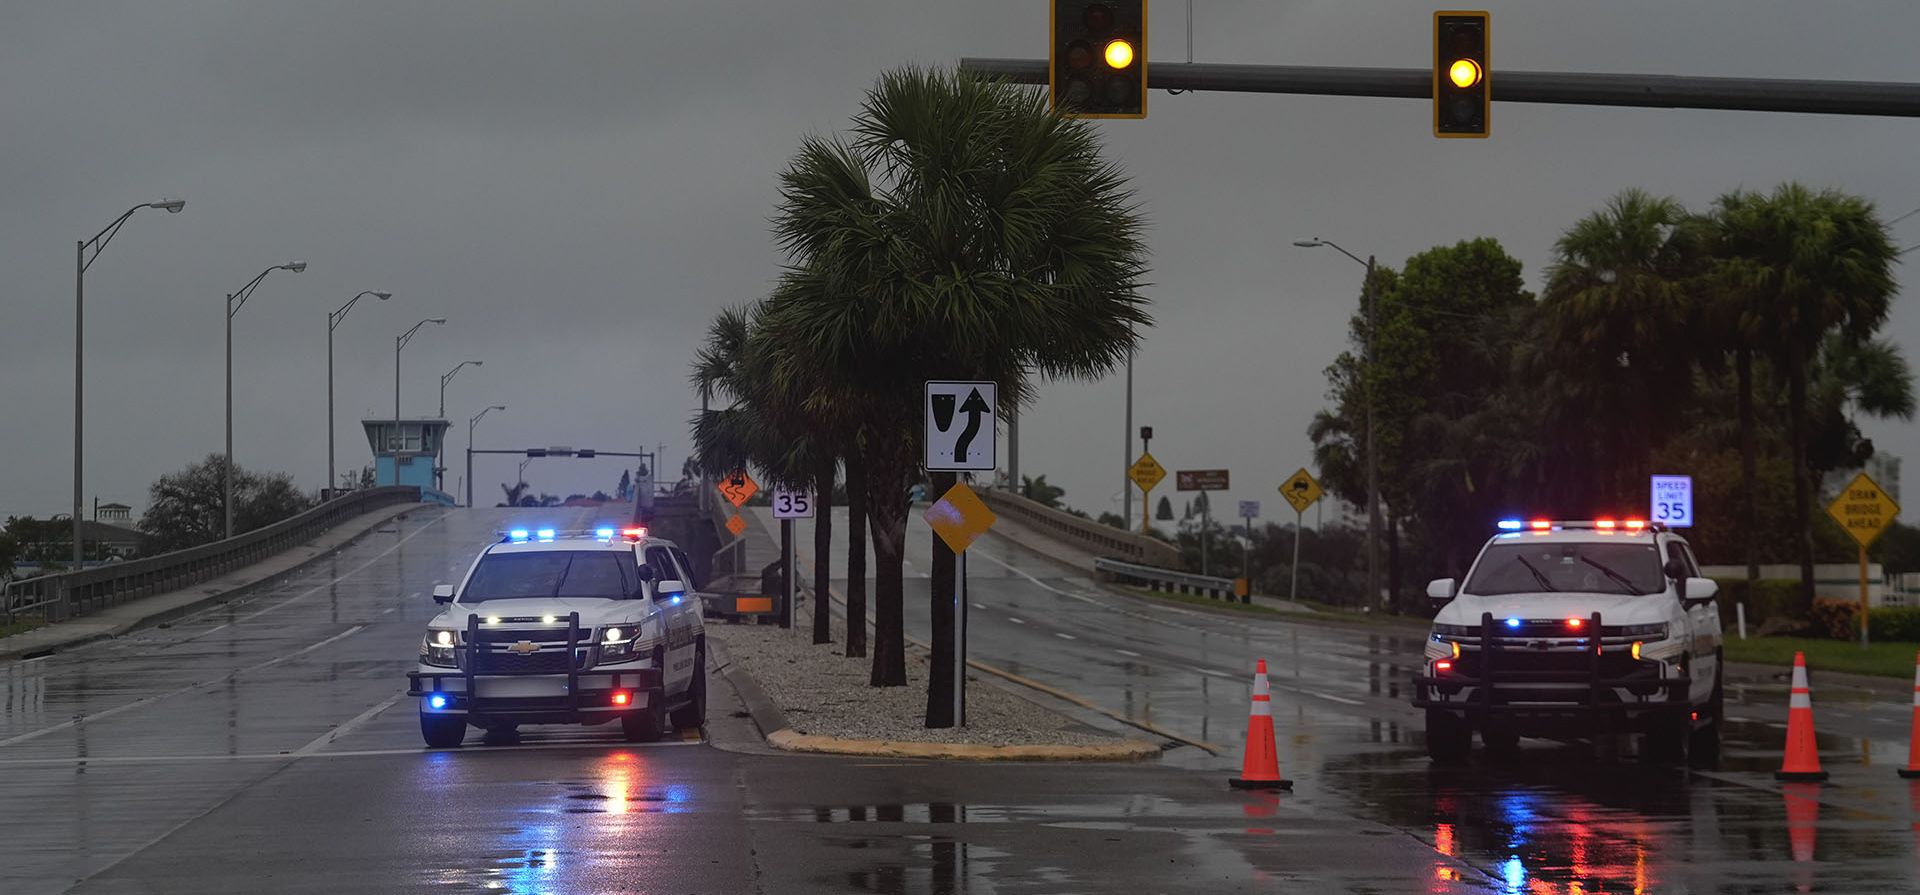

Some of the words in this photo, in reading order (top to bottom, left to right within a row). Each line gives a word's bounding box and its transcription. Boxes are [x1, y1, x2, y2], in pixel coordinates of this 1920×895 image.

[1656, 481, 1687, 489] SPEED
[1658, 491, 1684, 500] LIMIT
[778, 495, 808, 513] 35
[1657, 502, 1685, 520] 35
[1845, 504, 1881, 515] BRIDGE
[1847, 518, 1881, 528] AHEAD
